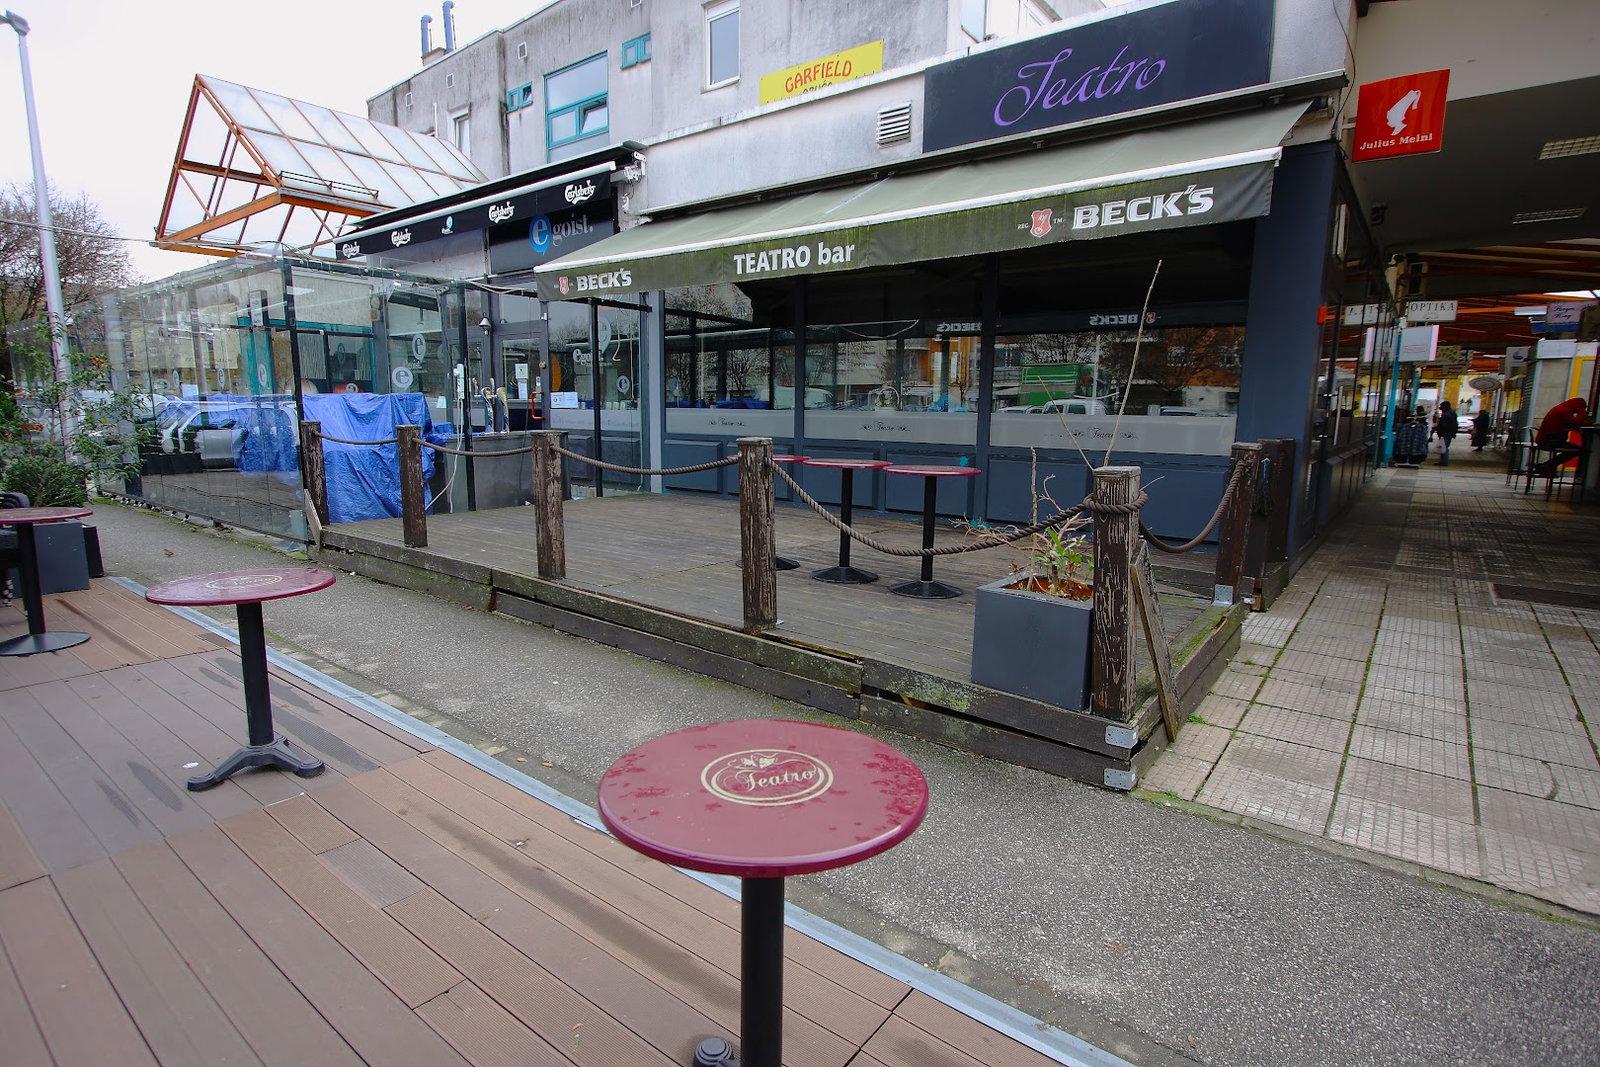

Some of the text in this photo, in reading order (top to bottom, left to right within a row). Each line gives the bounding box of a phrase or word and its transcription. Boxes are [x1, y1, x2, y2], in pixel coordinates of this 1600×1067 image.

[784, 60, 852, 93] GARFIELD
[994, 48, 1166, 126] Teatro
[1360, 133, 1433, 150] Julius Meinl
[565, 182, 596, 205] Carlsberg
[1072, 184, 1214, 230] BECK'S
[733, 242, 855, 275] TEATRO bar
[576, 268, 632, 291] BECK'S
[1410, 302, 1454, 312] OPTIKA
[724, 769, 815, 792] Teatro
